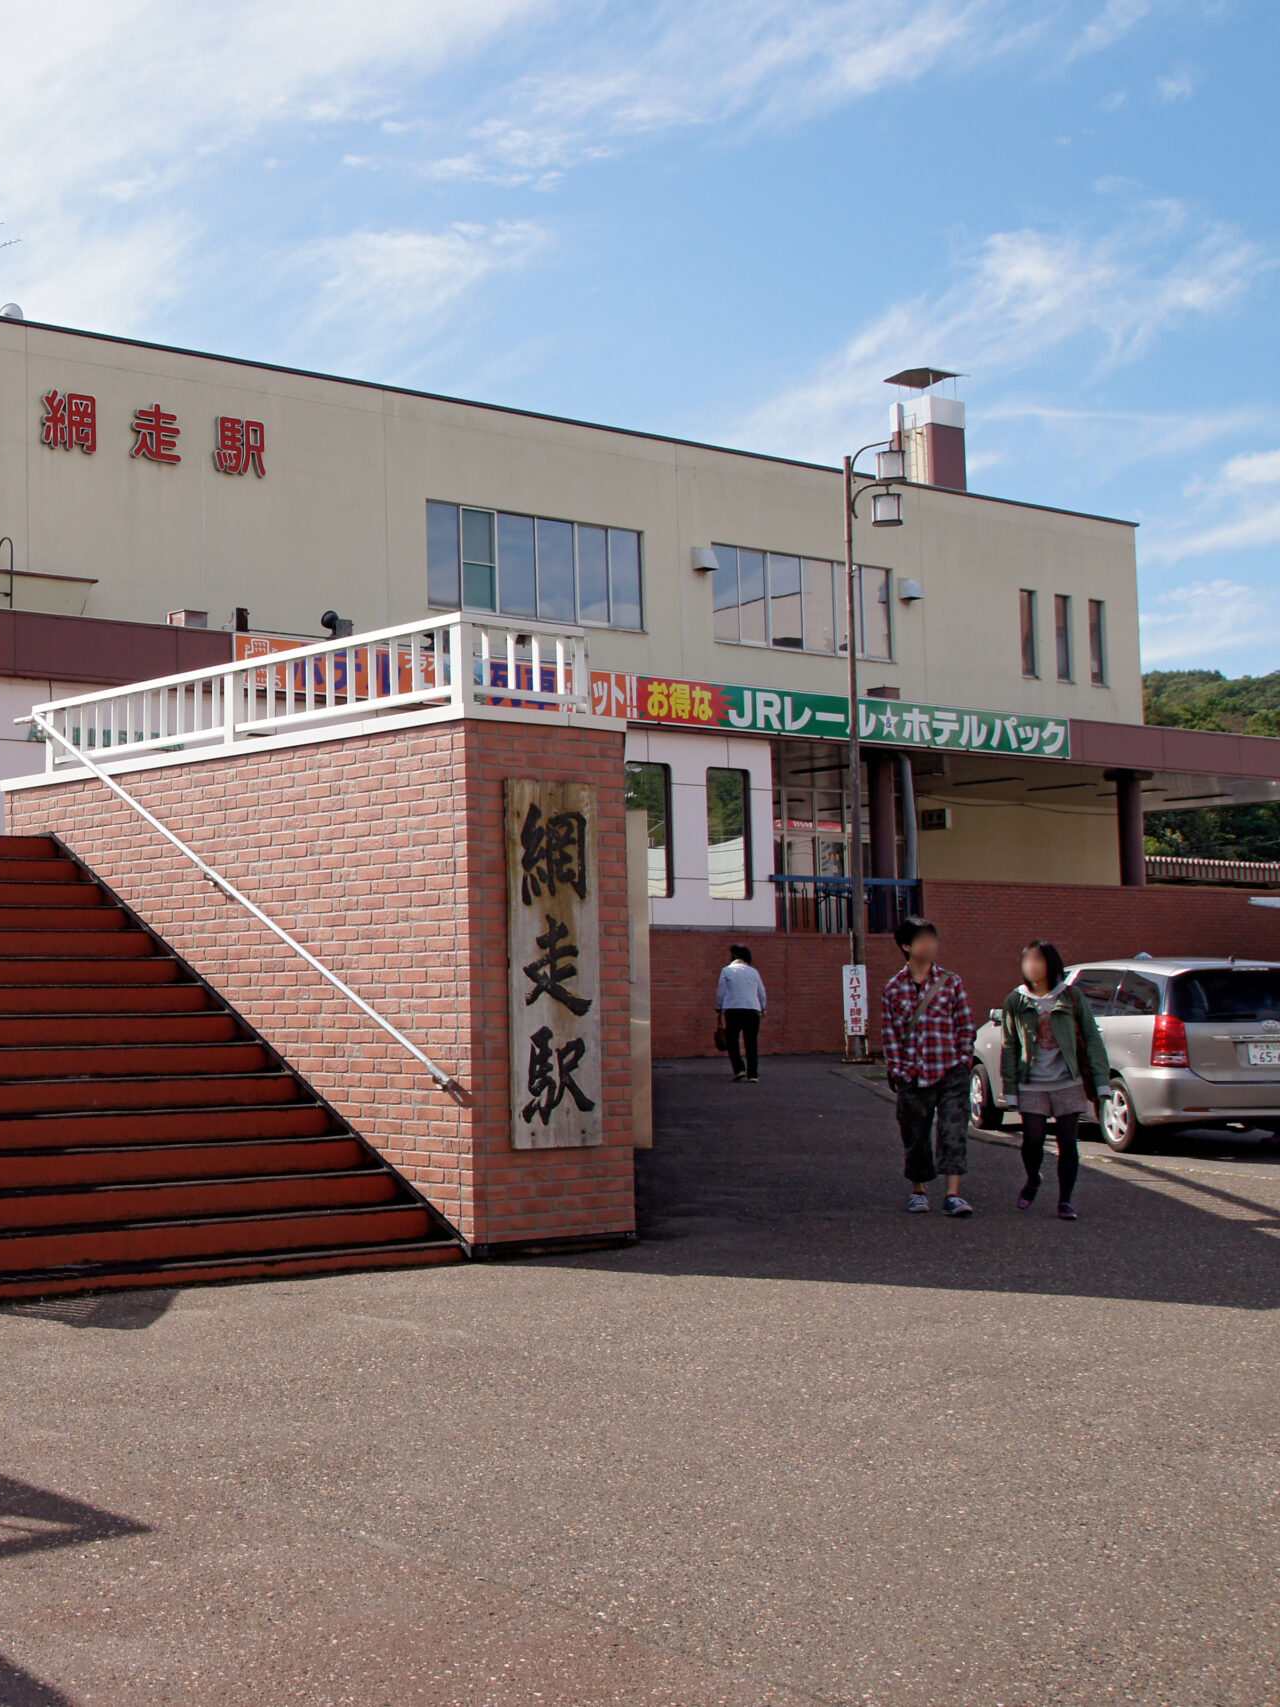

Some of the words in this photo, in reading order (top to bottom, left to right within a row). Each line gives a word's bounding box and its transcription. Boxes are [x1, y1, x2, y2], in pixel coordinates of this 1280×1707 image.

[40, 389, 266, 477] 網走駅
[647, 681, 714, 721] お得な
[520, 803, 597, 1126] 網走駅
